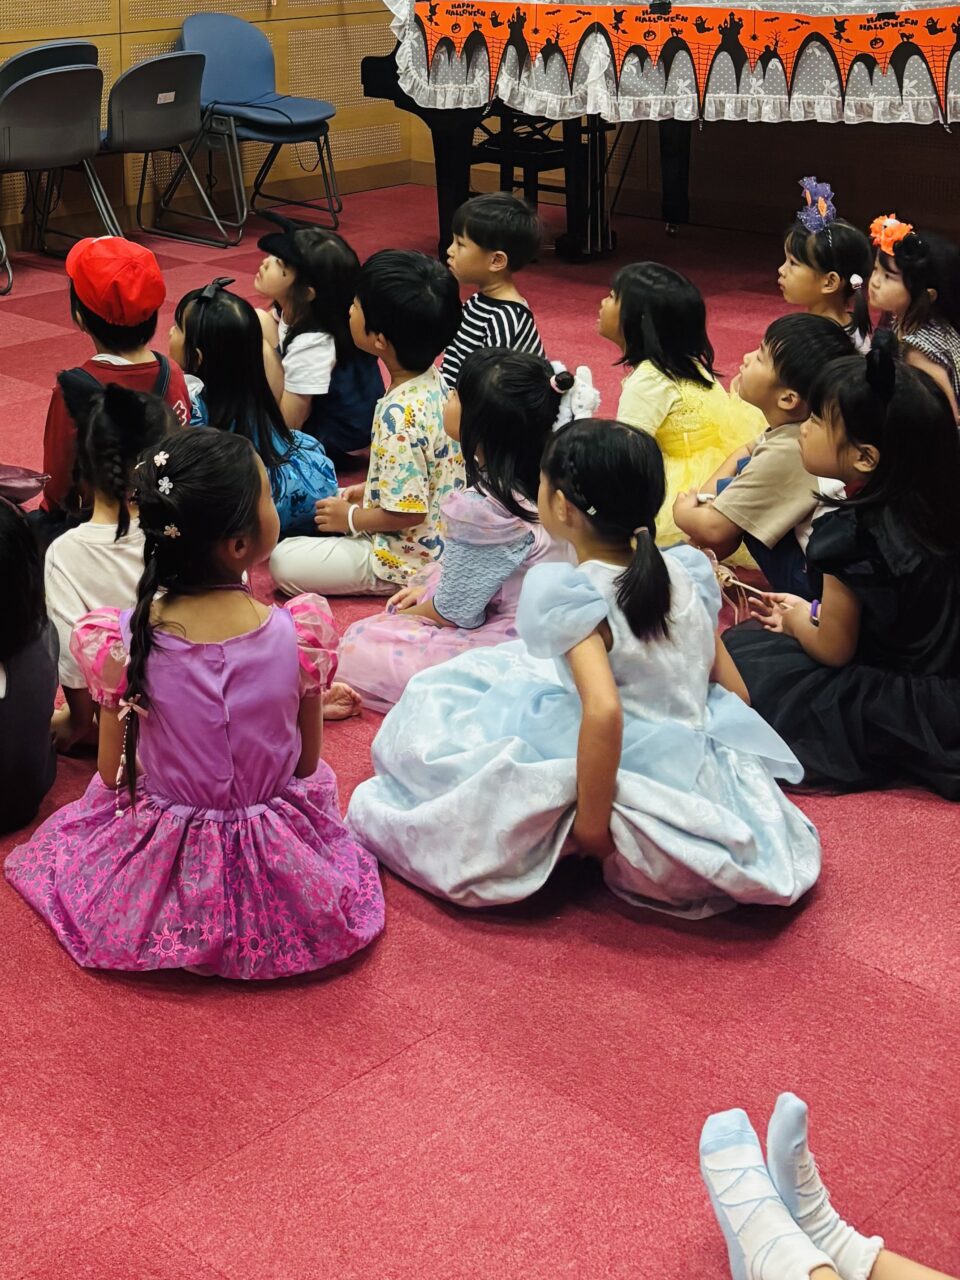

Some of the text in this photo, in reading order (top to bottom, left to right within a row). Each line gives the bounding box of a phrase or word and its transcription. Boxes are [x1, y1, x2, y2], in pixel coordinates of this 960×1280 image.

[451, 2, 475, 10] HAPPY
[445, 9, 486, 17] HALLOWEEN
[634, 13, 689, 23] HALLOWEEN
[859, 18, 919, 32] HALLOWEEN
